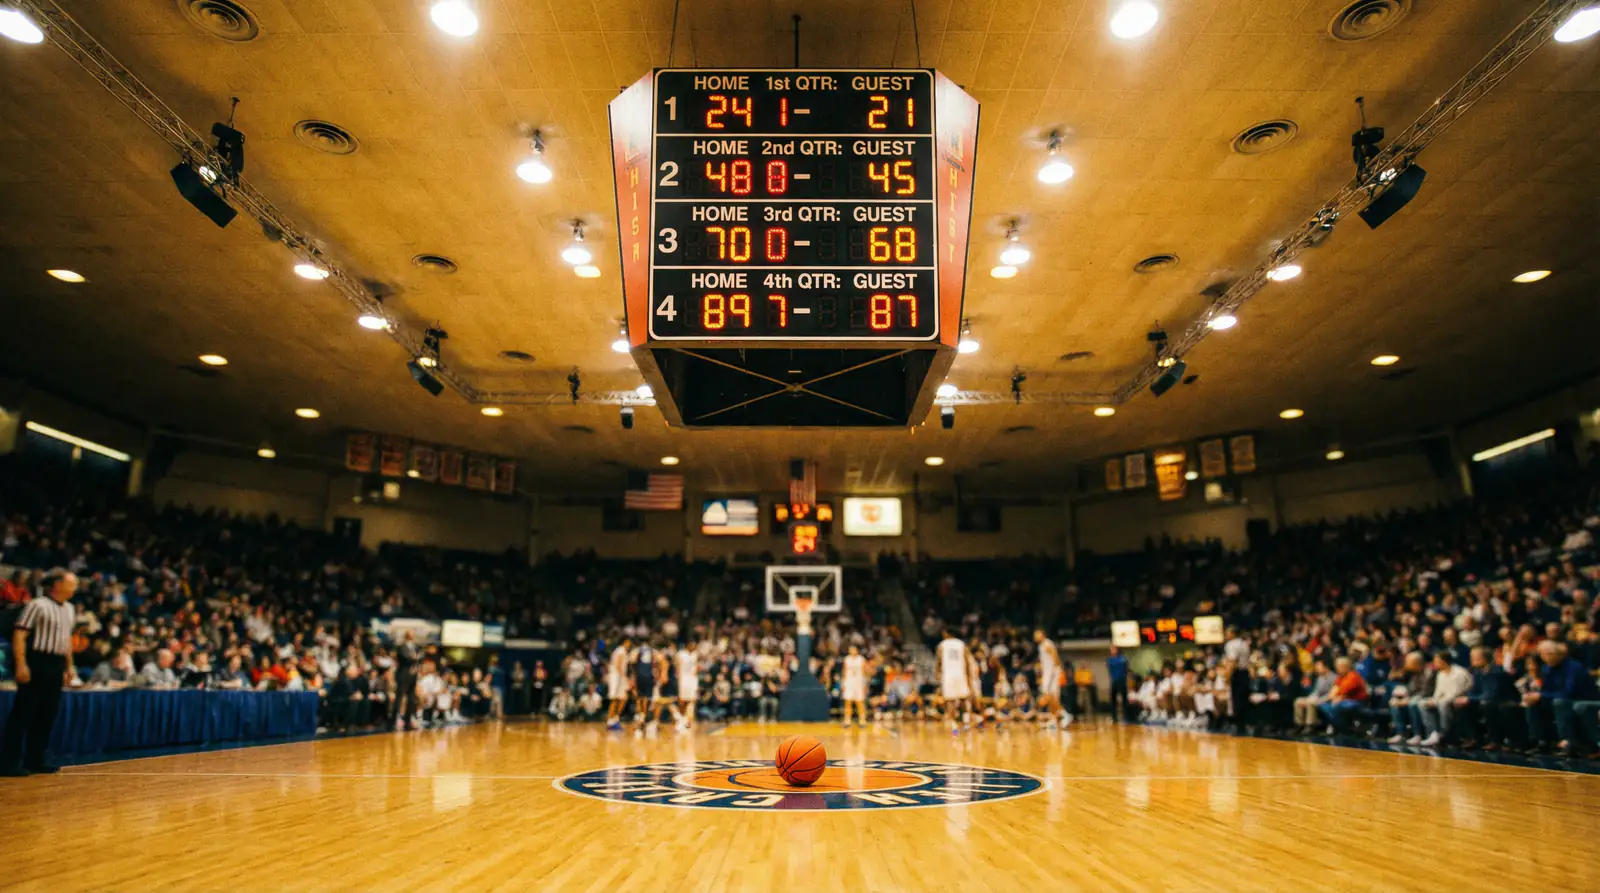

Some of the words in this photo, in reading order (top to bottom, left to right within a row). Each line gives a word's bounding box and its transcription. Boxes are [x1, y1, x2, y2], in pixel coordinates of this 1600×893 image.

[694, 75, 749, 91] HOME
[766, 76, 791, 91] 1st
[795, 75, 837, 92] QTR:
[851, 75, 915, 91] GUEST
[664, 96, 677, 121] 1
[705, 95, 753, 128] 24
[867, 96, 915, 128] 21
[693, 139, 749, 155] HOME
[761, 140, 795, 156] 2nd
[799, 140, 843, 156] QTR:
[852, 140, 916, 156] GUEST
[659, 160, 679, 187] 2
[705, 160, 753, 195] 48
[868, 160, 917, 195] 45
[692, 206, 749, 222] HOME
[763, 206, 793, 222] 3rd
[797, 206, 841, 223] QTR:
[853, 206, 917, 222] GUEST
[658, 227, 678, 254] 3
[705, 226, 753, 262] 70
[868, 226, 918, 263] 68
[691, 272, 748, 289] HOME
[763, 273, 793, 289] 4th
[797, 272, 841, 290] QTR:
[853, 272, 918, 290] GUEST
[656, 294, 677, 322] 4
[702, 294, 752, 330] 89
[869, 294, 919, 330] 87
